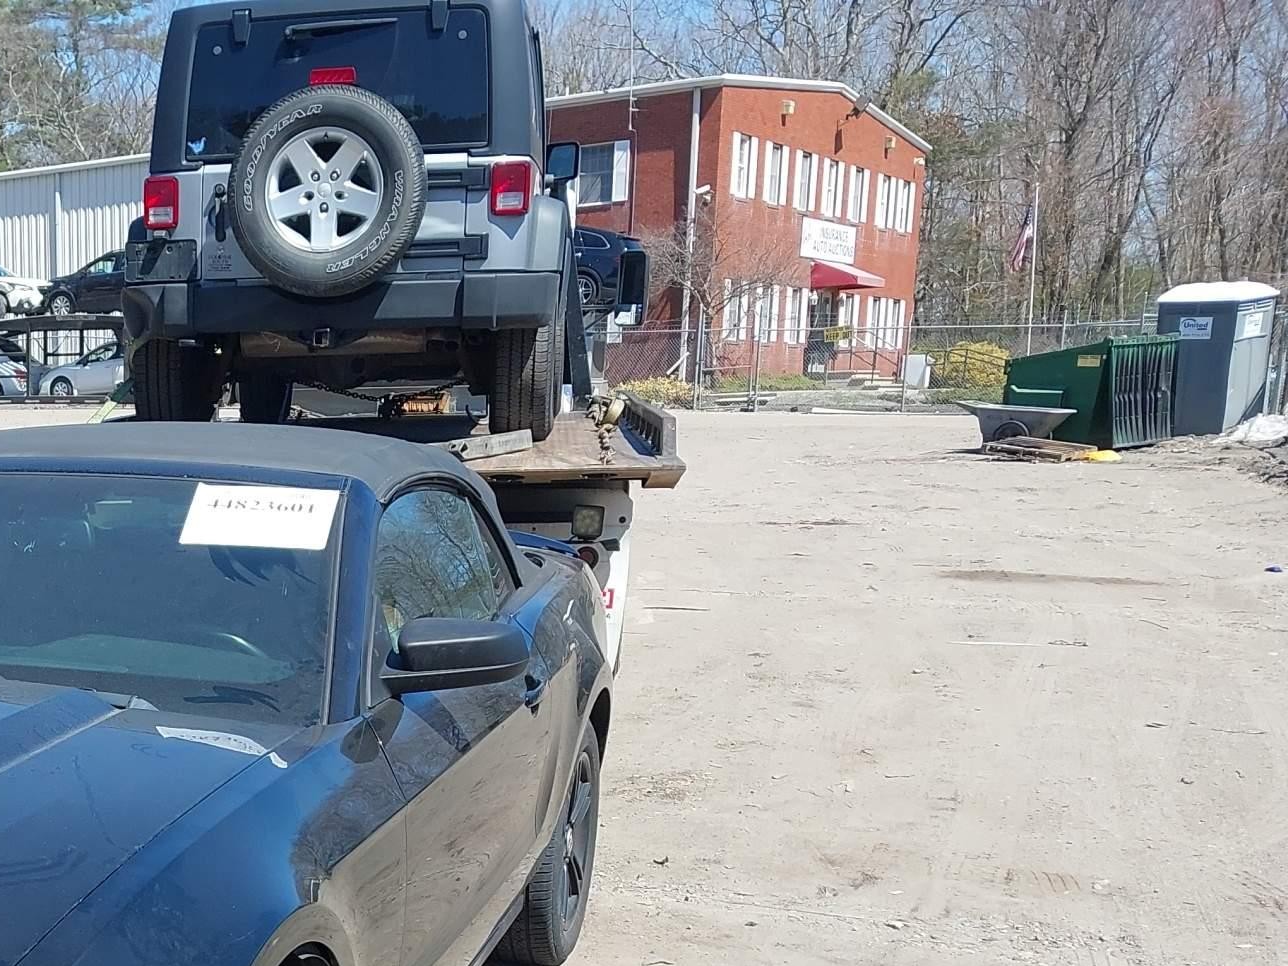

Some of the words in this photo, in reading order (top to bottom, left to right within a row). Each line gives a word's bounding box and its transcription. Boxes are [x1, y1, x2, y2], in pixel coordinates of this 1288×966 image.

[242, 103, 323, 212] GOODYEAR
[326, 169, 404, 273] WRANGLER
[1183, 319, 1209, 329] United
[825, 331, 840, 341] KEEP
[842, 330, 852, 340] OUT
[208, 497, 316, 514] 44823601
